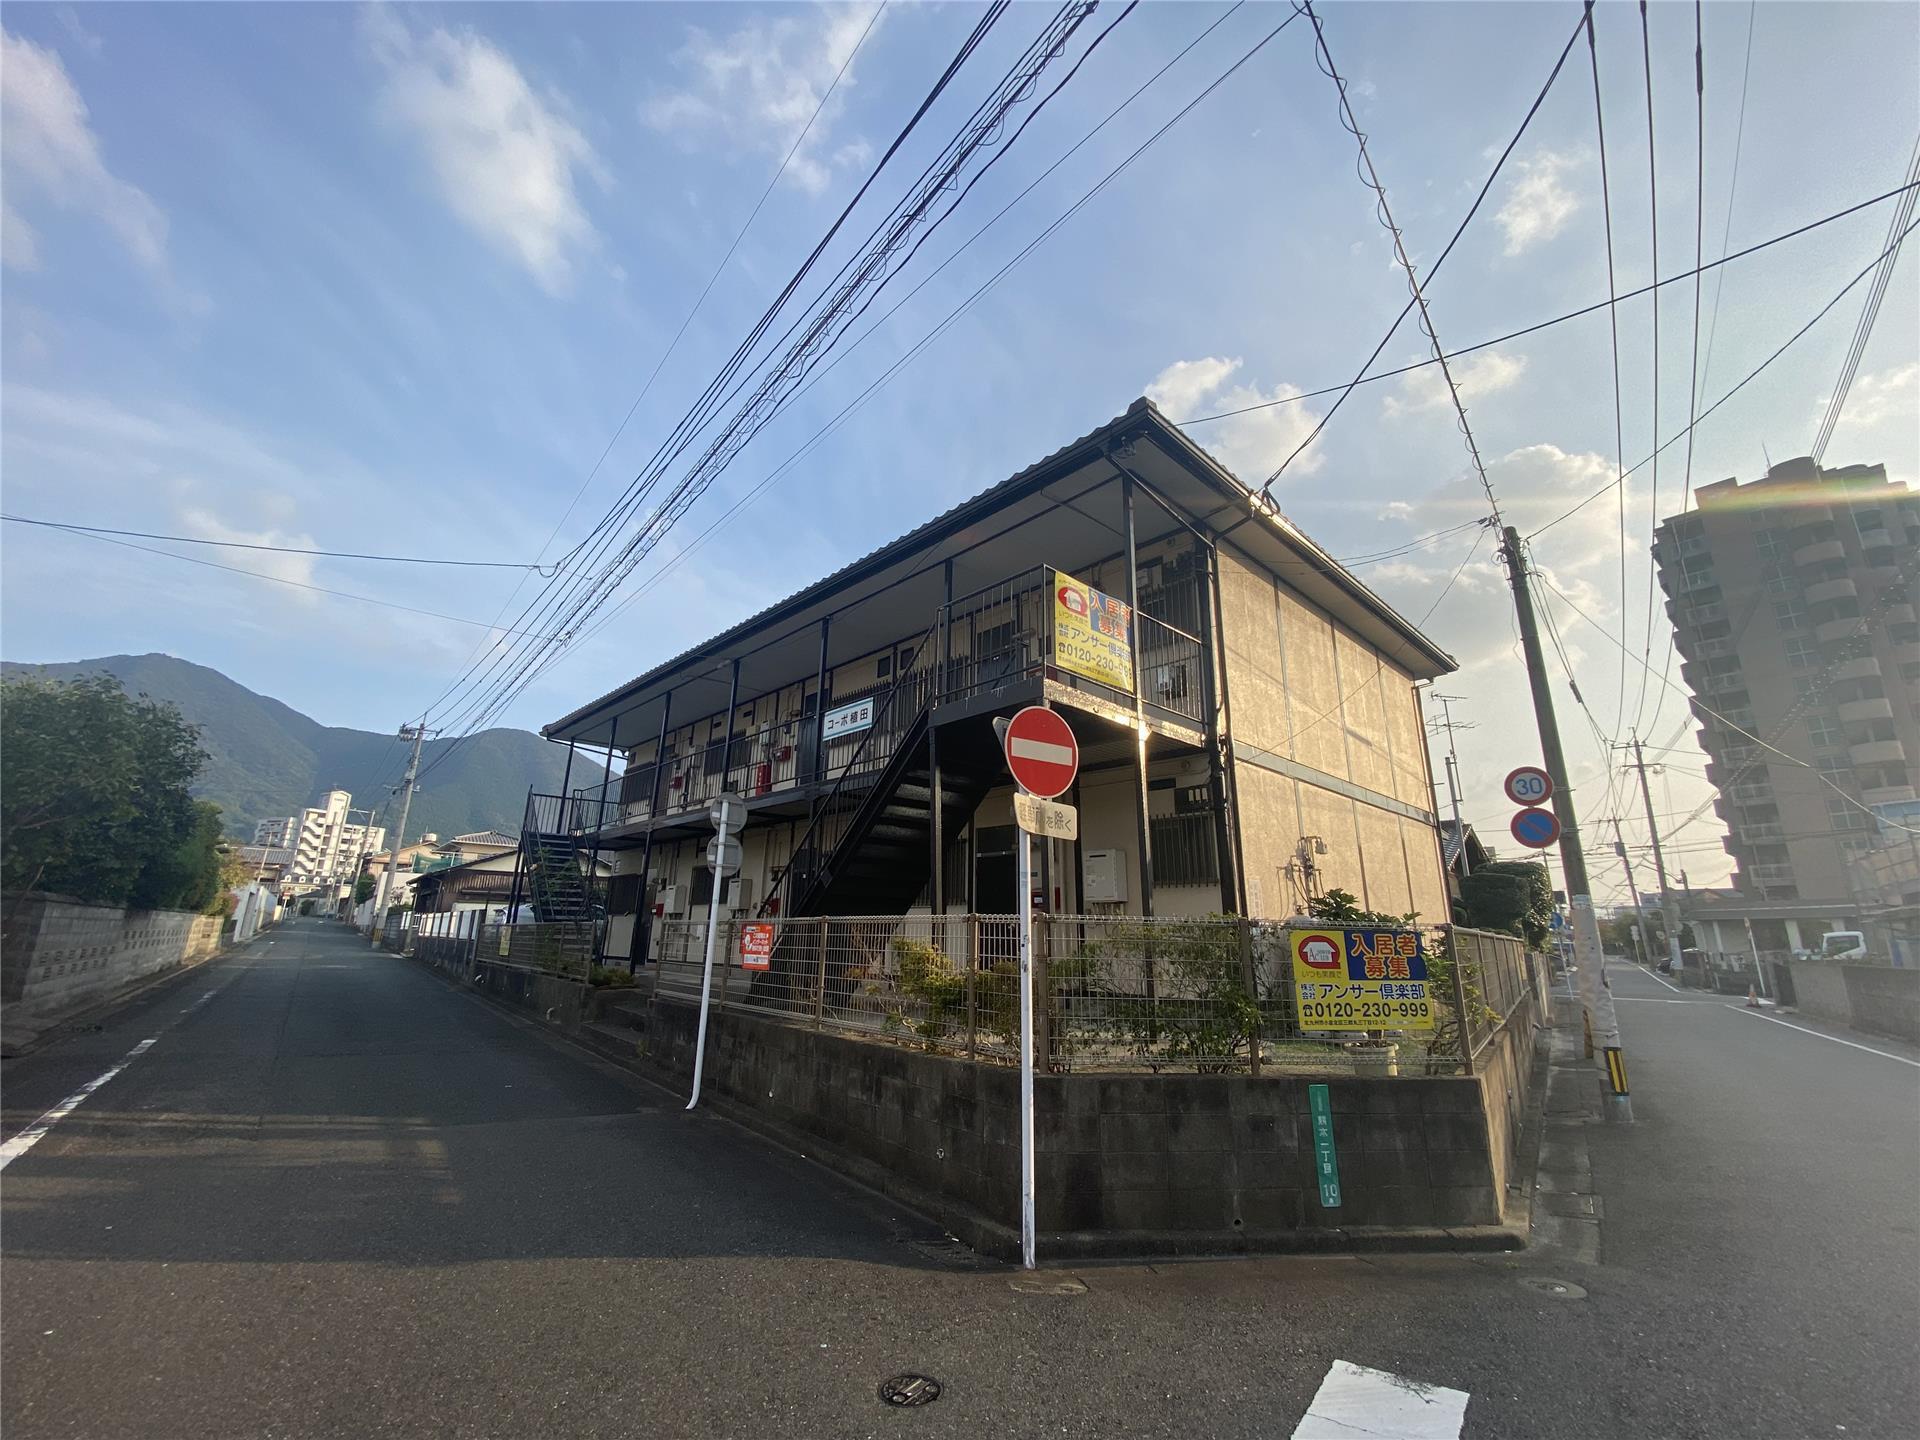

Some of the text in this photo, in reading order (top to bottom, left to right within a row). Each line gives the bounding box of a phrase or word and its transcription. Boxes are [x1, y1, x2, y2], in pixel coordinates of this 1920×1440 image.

[1098, 613, 1128, 643] 募集
[1516, 777, 1543, 796] 30
[1351, 933, 1417, 956] 入居者
[1363, 955, 1411, 979] 募集
[1319, 983, 1426, 1000] アンサー倶楽部
[1315, 1002, 1429, 1018] 0120-230-999
[1323, 1184, 1338, 1197] 10
